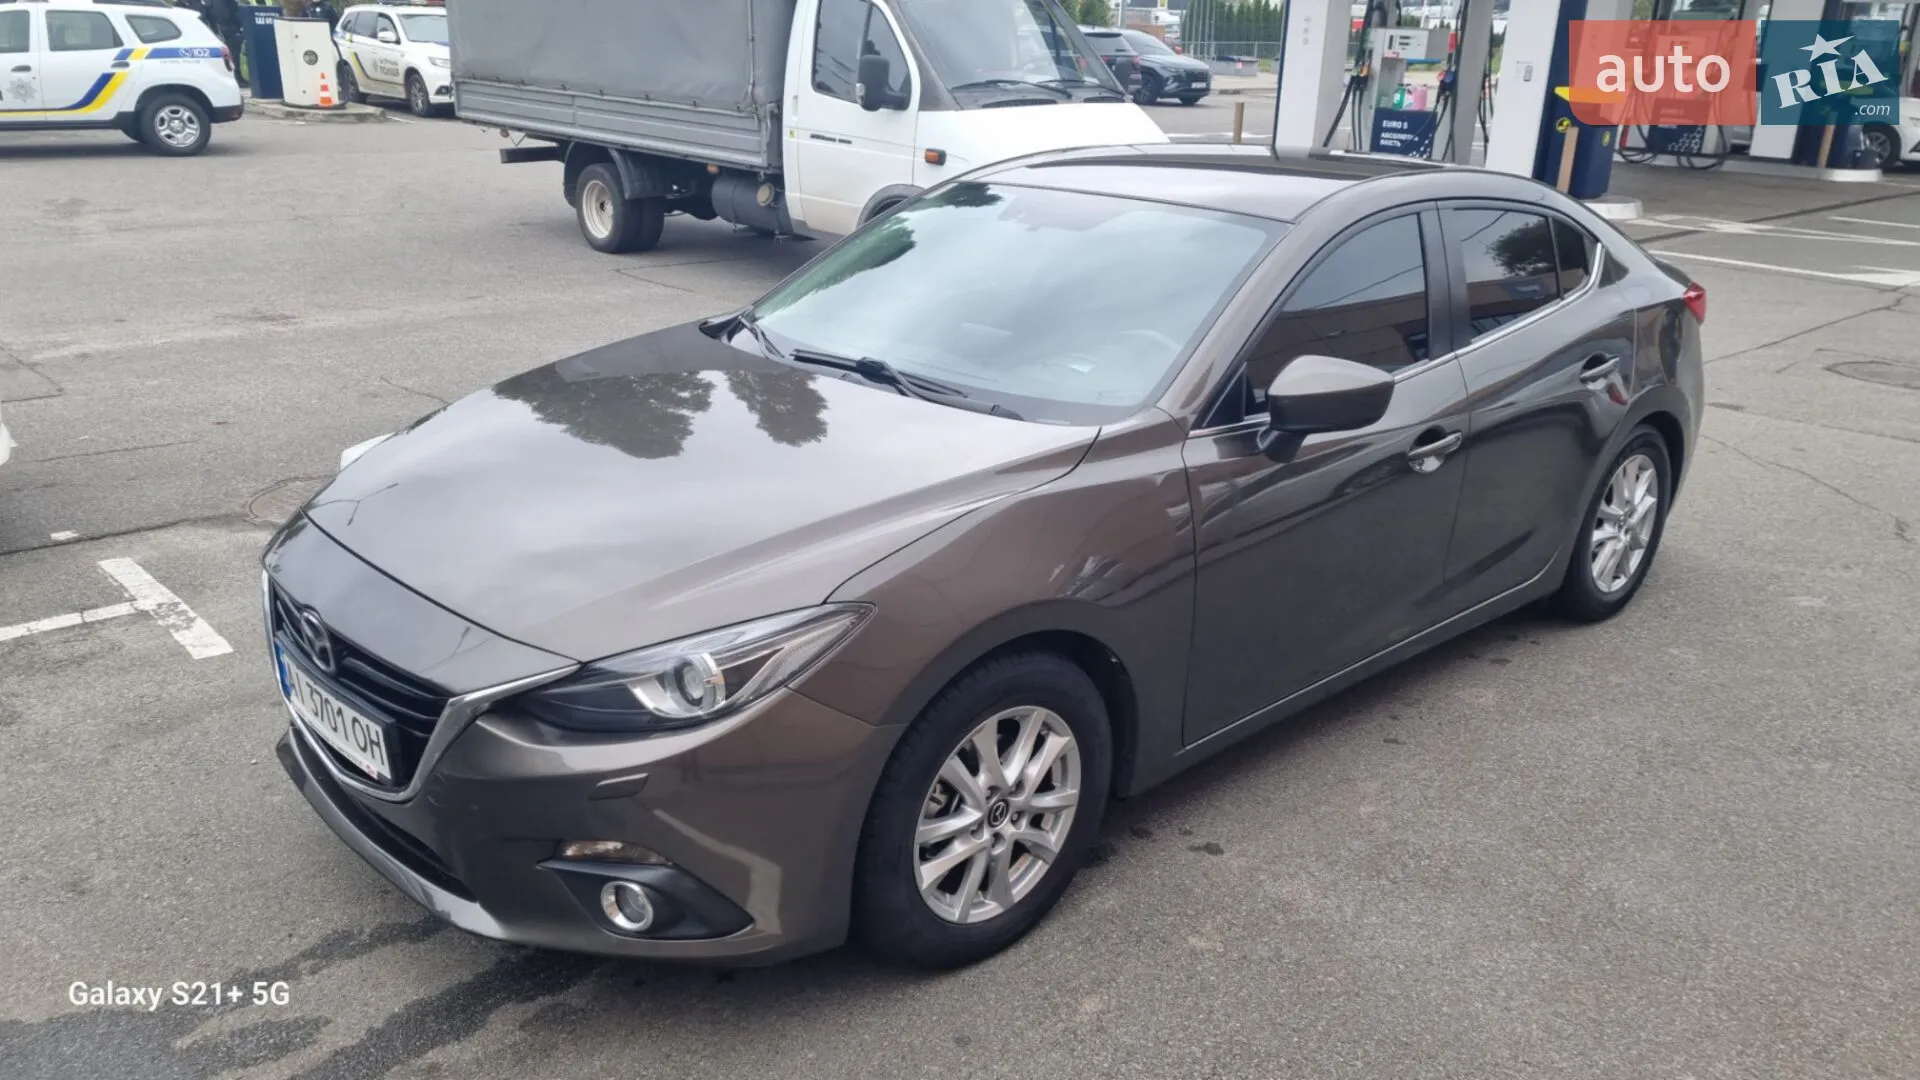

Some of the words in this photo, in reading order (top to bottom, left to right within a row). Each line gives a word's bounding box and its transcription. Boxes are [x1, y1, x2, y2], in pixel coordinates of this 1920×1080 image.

[192, 48, 210, 57] 102
[1382, 120, 1402, 129] EURO
[305, 680, 349, 742] 3701
